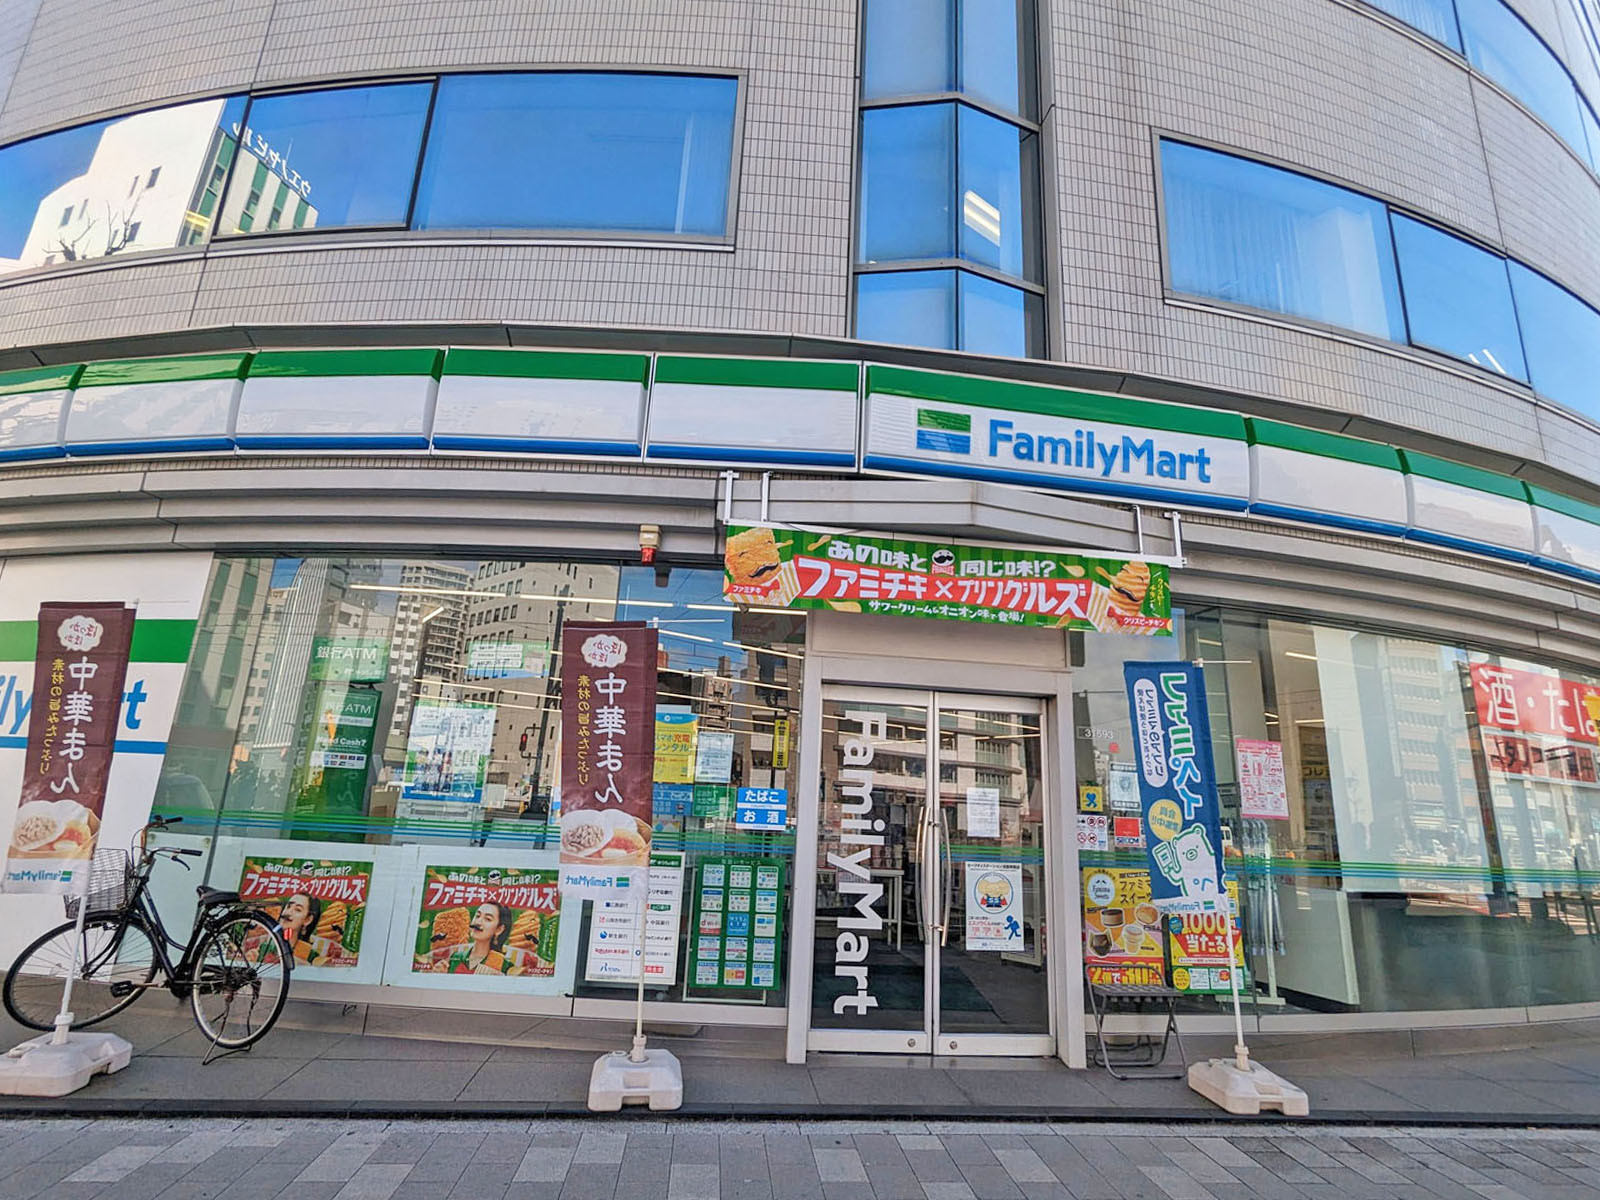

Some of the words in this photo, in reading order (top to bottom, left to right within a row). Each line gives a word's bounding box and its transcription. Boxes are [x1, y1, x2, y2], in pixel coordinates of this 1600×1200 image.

[989, 419, 1212, 484] FamilyMart
[828, 539, 928, 573] あの味と
[960, 559, 1057, 578] 同じ味!?
[732, 584, 762, 595] ファミチキ
[798, 557, 1088, 620] ファミチキ×プリングルズ
[868, 600, 1025, 623] サワークリーム&オニオン味で登場!
[315, 646, 378, 660] 銀行ATM
[745, 789, 780, 803] たばこ
[743, 810, 780, 824] お酒
[264, 862, 301, 877] あの味と
[827, 710, 888, 1016] FamilyMart
[244, 873, 366, 902] ファミチキ×プリングルズ
[448, 872, 487, 885] あの味と
[428, 882, 558, 911] ファミチキ×プリングルズ
